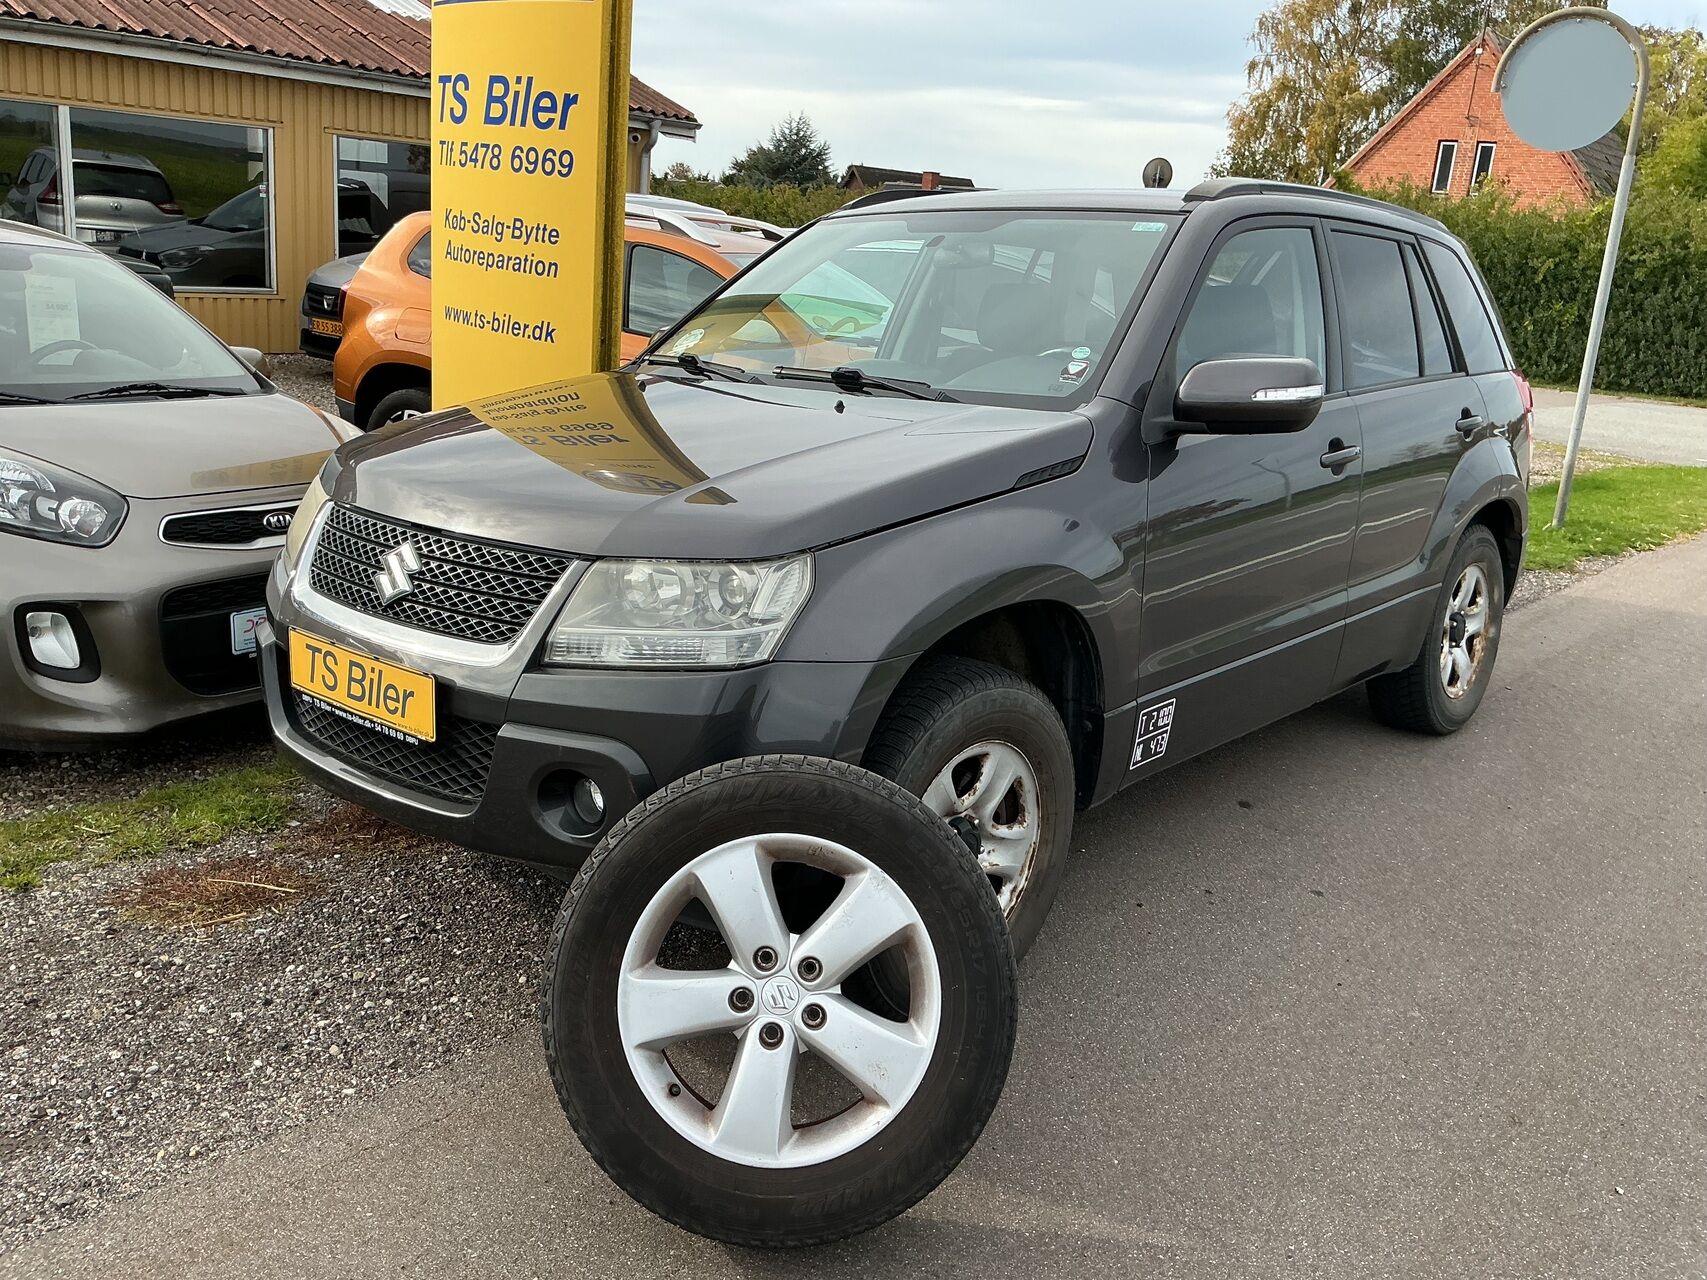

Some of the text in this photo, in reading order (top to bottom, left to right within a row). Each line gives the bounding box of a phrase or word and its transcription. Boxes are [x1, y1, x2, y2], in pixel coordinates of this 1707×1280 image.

[437, 73, 580, 131] TS Biler
[510, 145, 575, 178] 6969
[444, 207, 560, 245] Køb-Salg-Bytte
[445, 239, 559, 279] Autoreparation
[444, 304, 557, 343] www.ts-biler.dk
[305, 643, 415, 719] TS Biler
[1140, 716, 1147, 735] T
